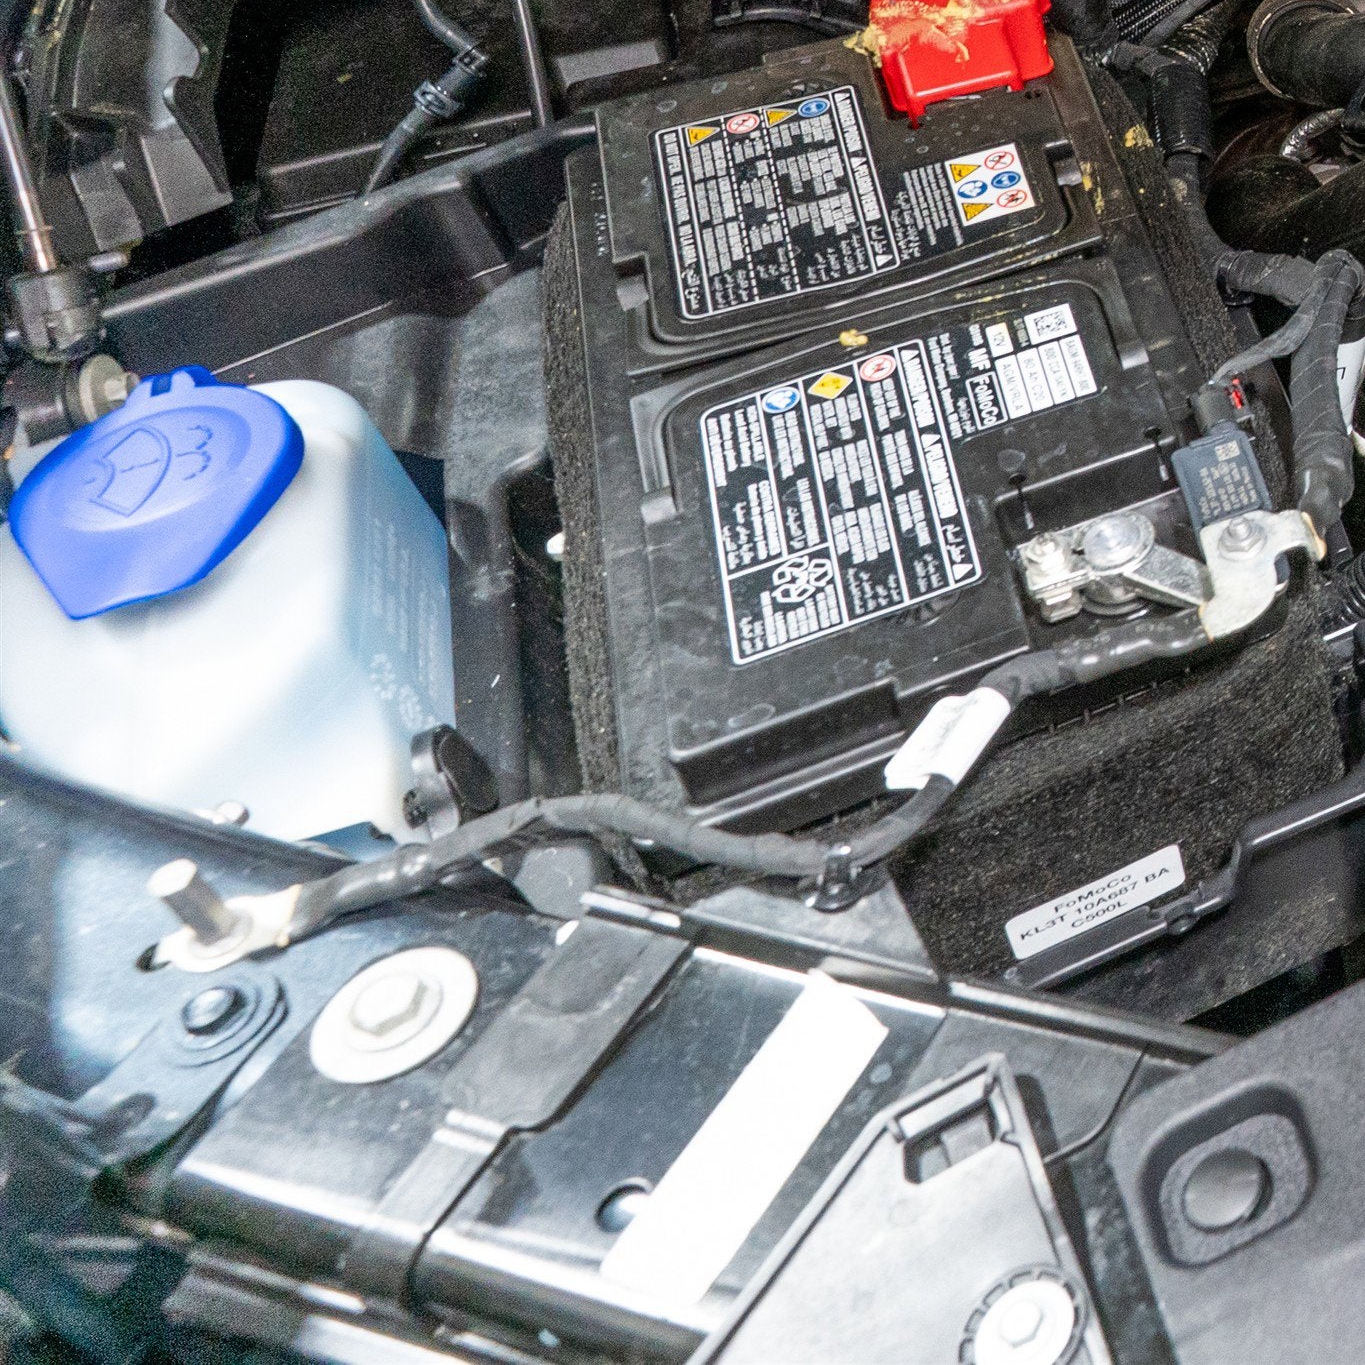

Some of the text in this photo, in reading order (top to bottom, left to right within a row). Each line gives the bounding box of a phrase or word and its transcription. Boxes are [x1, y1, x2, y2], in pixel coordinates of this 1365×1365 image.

[970, 375, 1002, 426] FoMoCo
[1020, 866, 1170, 941] KL3T 10A687 BA
[1053, 874, 1133, 914] FoMoCo
[1070, 900, 1129, 930] C500L
